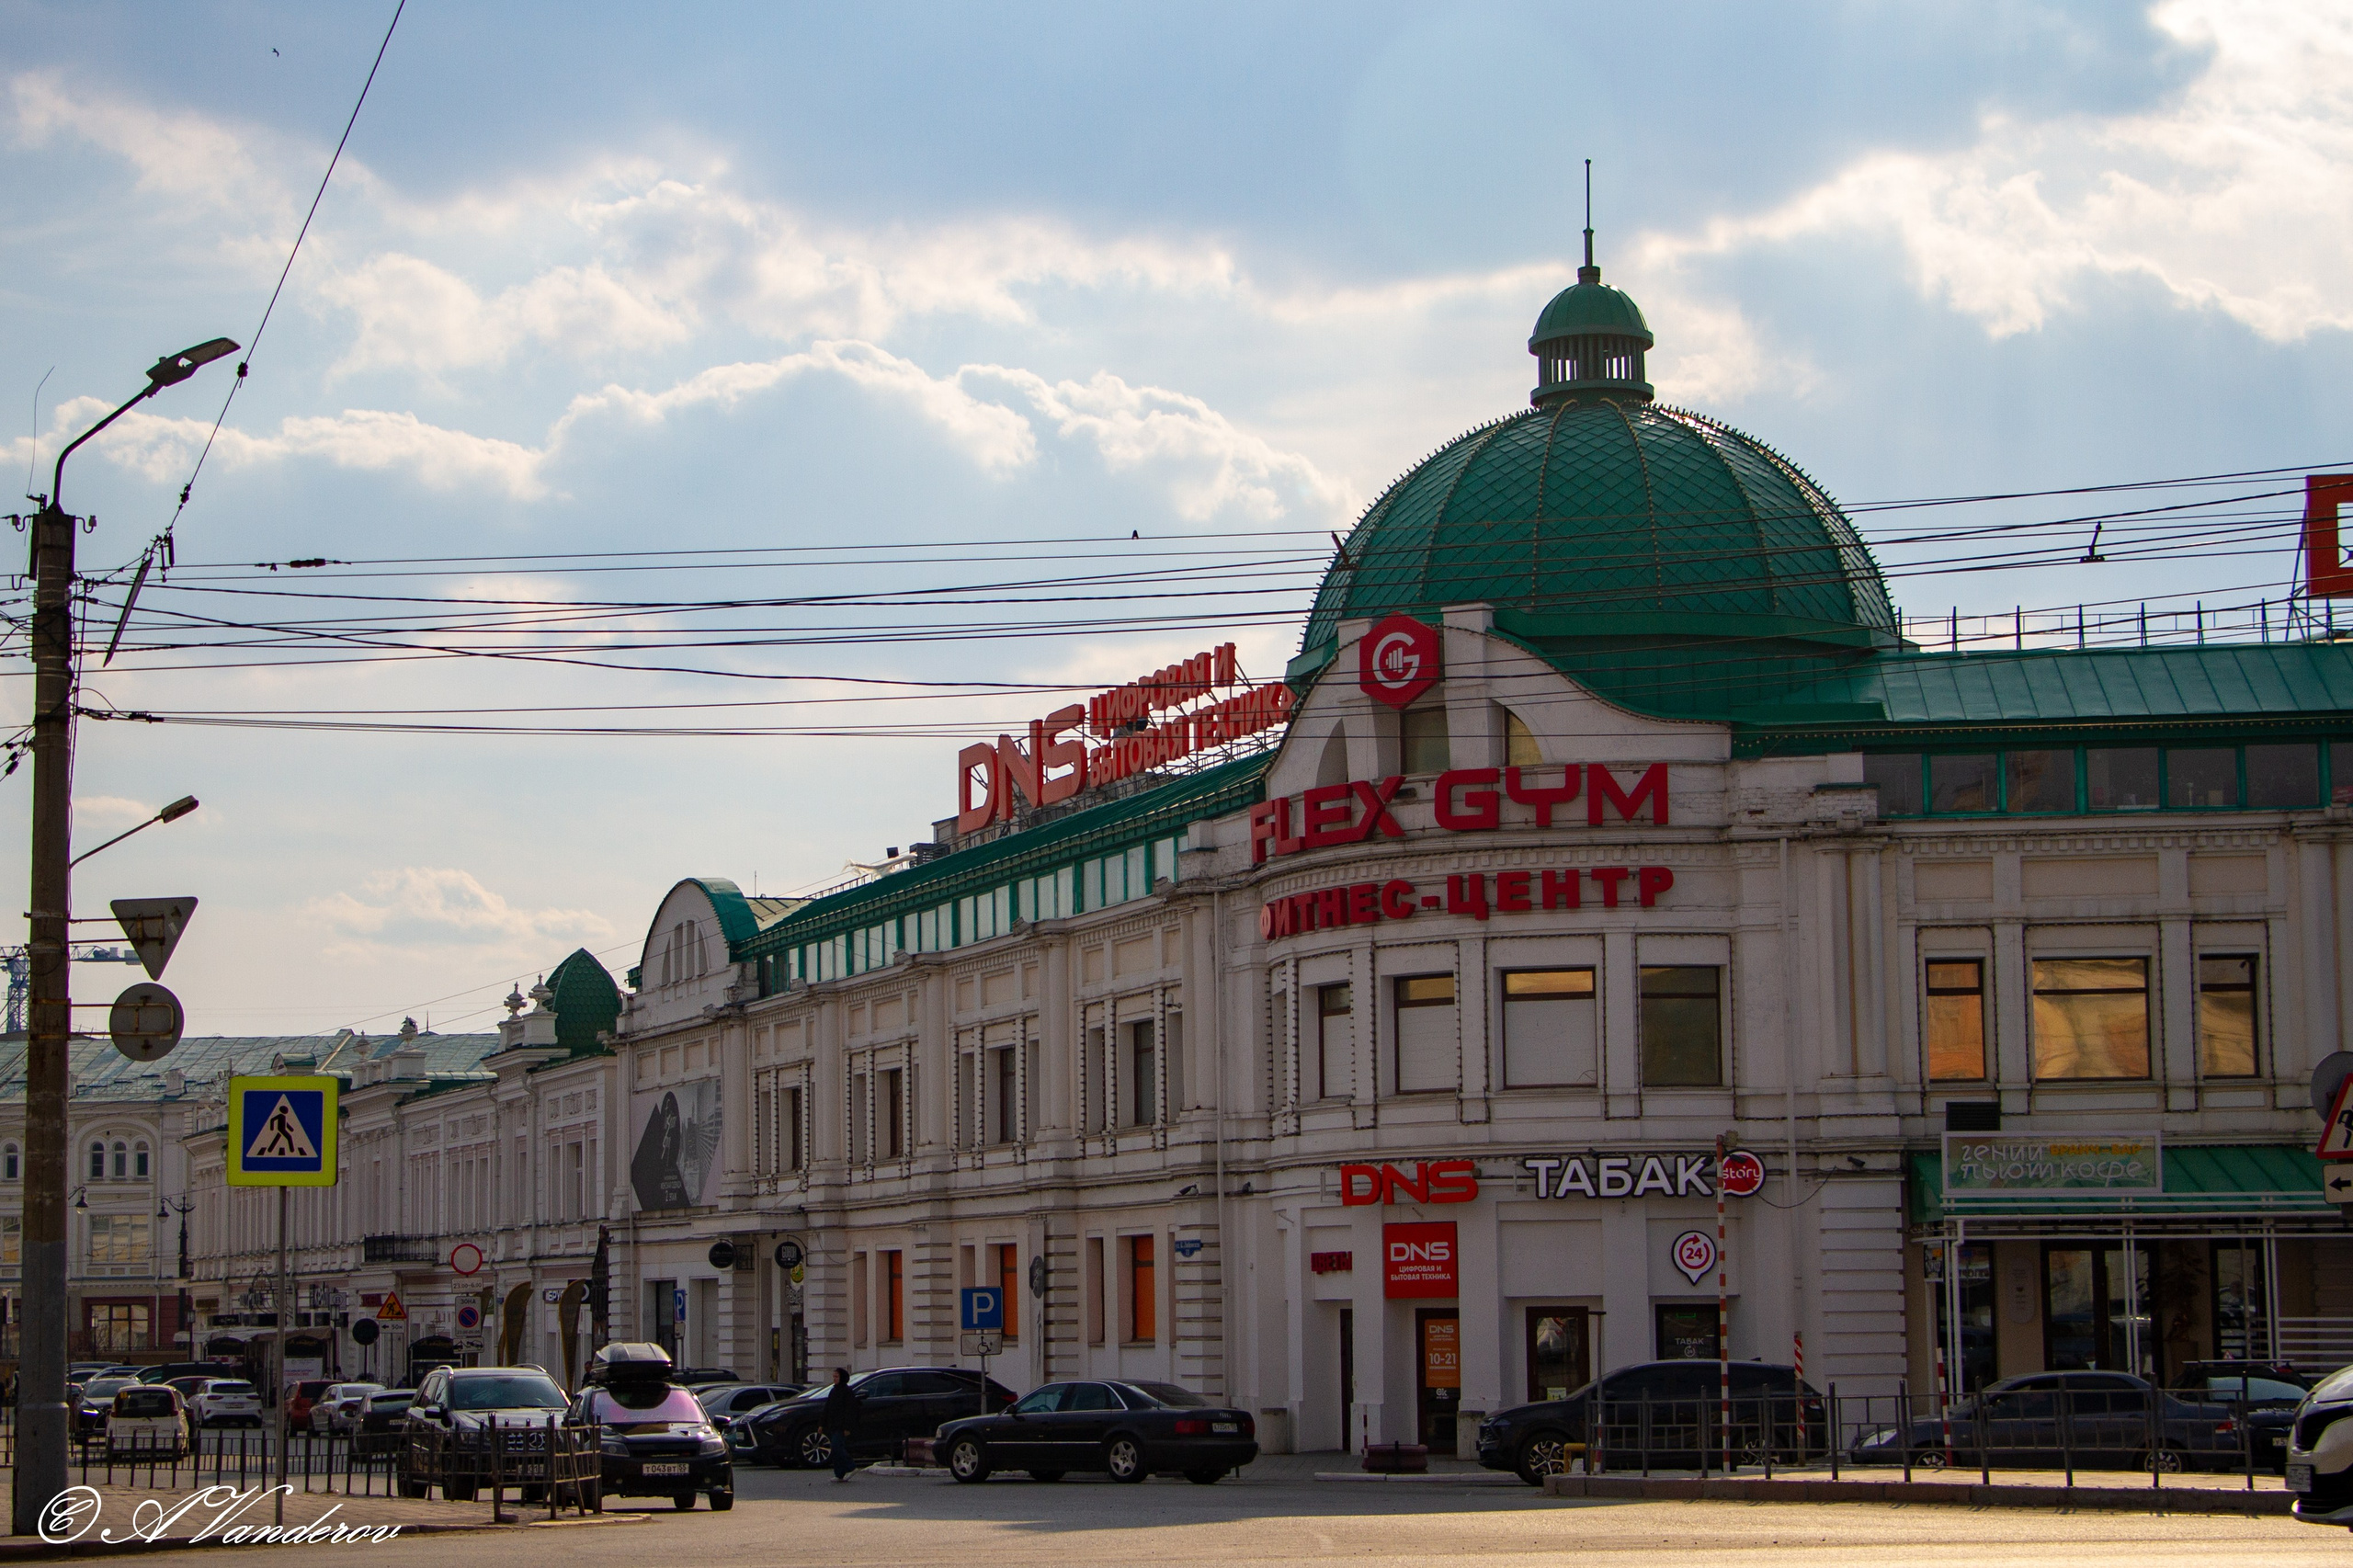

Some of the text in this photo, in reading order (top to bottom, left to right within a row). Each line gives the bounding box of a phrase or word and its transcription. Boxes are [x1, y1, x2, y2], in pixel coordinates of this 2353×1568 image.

[1090, 642, 1236, 739] ЦИФРОВАЯ И
[1090, 682, 1297, 788] БЫТОВАЯ ТЕХНИКА
[959, 704, 1088, 835] DNS
[1250, 763, 1668, 863] FLEX GYM
[1259, 867, 1675, 940] ФИТНЕС-ЦЕНТР
[1340, 1160, 1478, 1206] DNS
[1525, 1156, 1714, 1198] ТАБАК
[1961, 1161, 2143, 1187] пьют кофе
[1390, 1241, 1450, 1262] DNS
[1686, 1246, 1703, 1261] 24
[972, 1292, 994, 1324] P
[1429, 1324, 1454, 1334] DNS
[1429, 1353, 1457, 1365] 10-21
